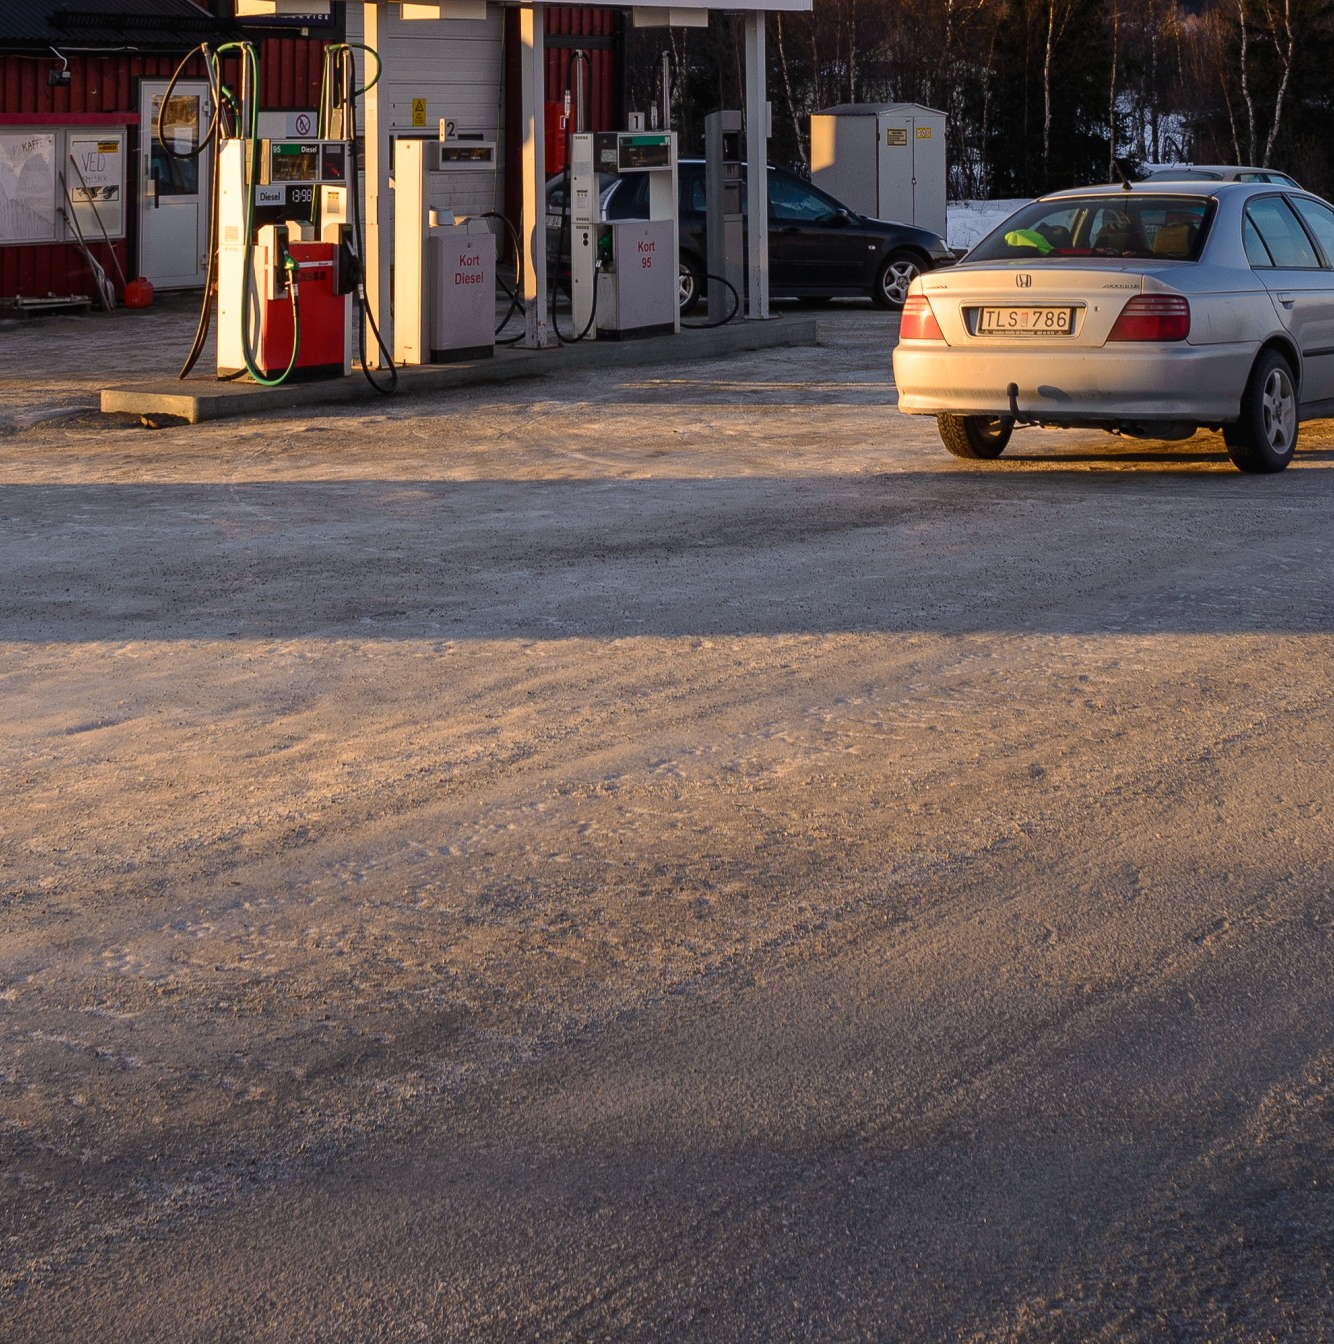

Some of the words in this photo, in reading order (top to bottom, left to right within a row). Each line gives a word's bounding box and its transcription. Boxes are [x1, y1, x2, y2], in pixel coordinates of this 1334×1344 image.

[633, 115, 639, 129] 1
[446, 121, 456, 137] 2
[21, 137, 44, 152] KAFFE
[272, 145, 282, 154] 95
[300, 145, 318, 154] Diesel
[81, 151, 106, 172] VED
[260, 191, 281, 202] Diesel
[637, 240, 656, 253] Kort
[459, 254, 480, 267] Kort
[641, 257, 652, 269] 95
[296, 271, 326, 283] assa
[454, 271, 484, 285] Diesel
[985, 310, 1018, 328] TLS
[1032, 310, 1067, 328] 786
